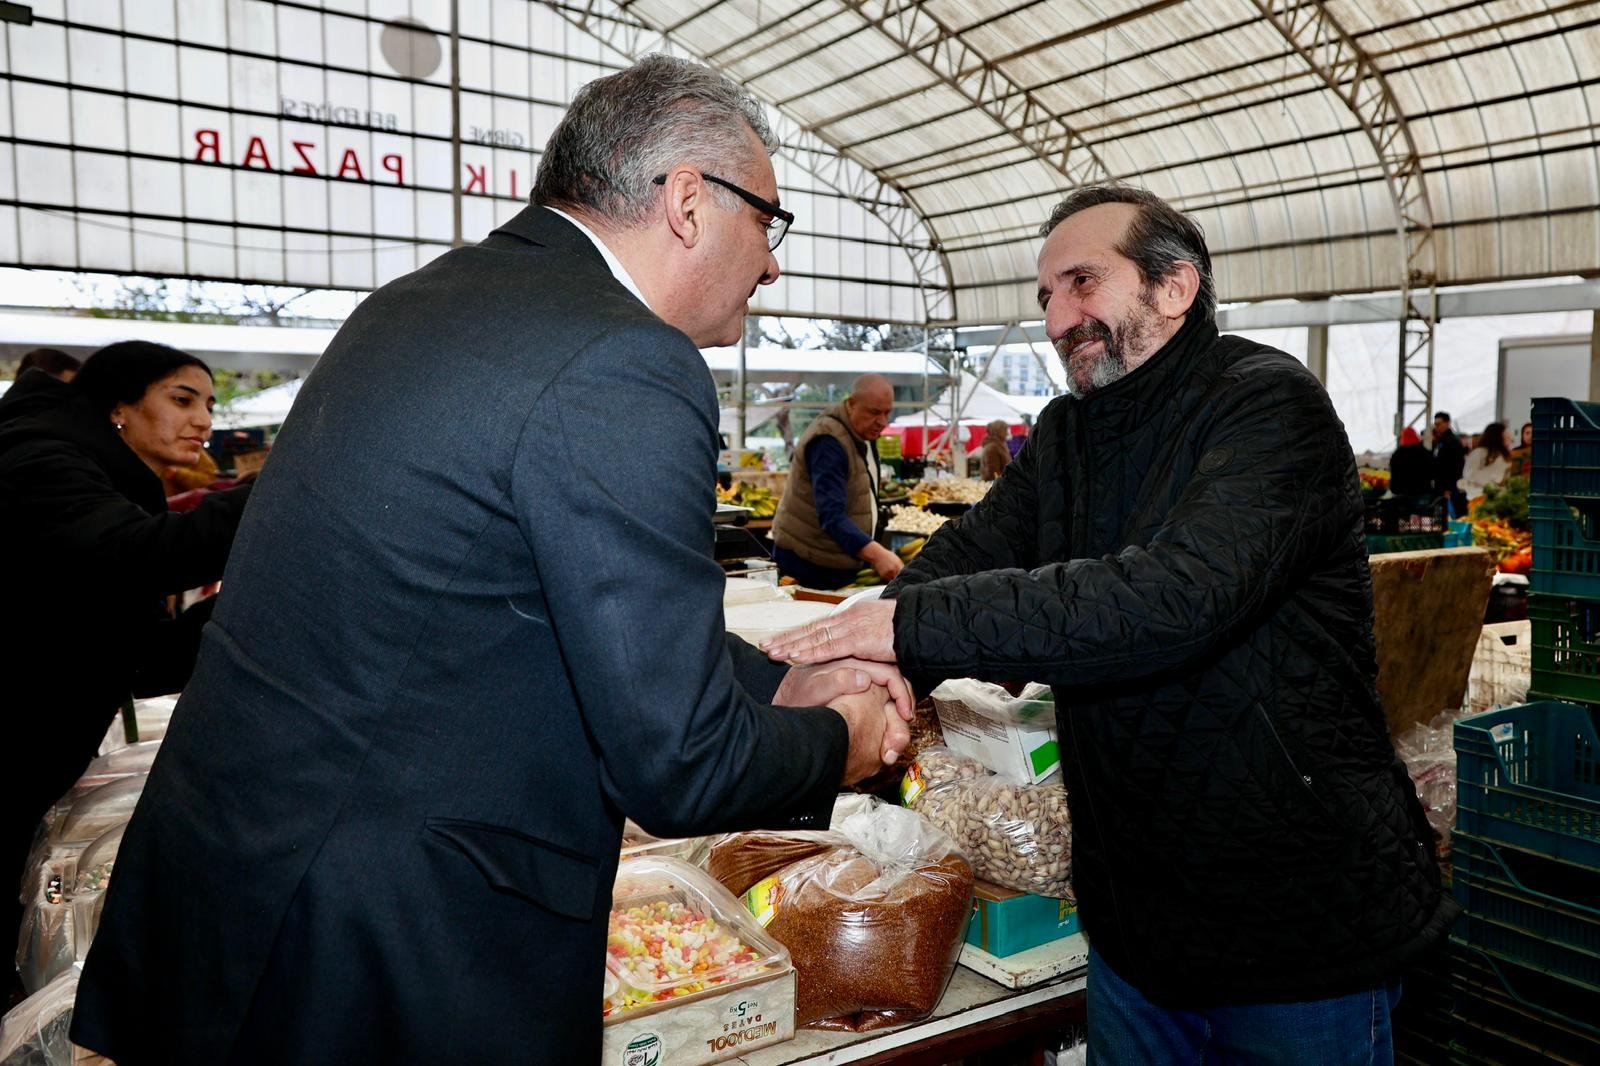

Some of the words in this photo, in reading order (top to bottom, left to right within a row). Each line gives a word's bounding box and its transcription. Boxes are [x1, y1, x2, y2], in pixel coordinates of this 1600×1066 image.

[738, 1001, 747, 1017] 5
[723, 1014, 762, 1031] DATES
[706, 1021, 777, 1053] MEDJOOL
